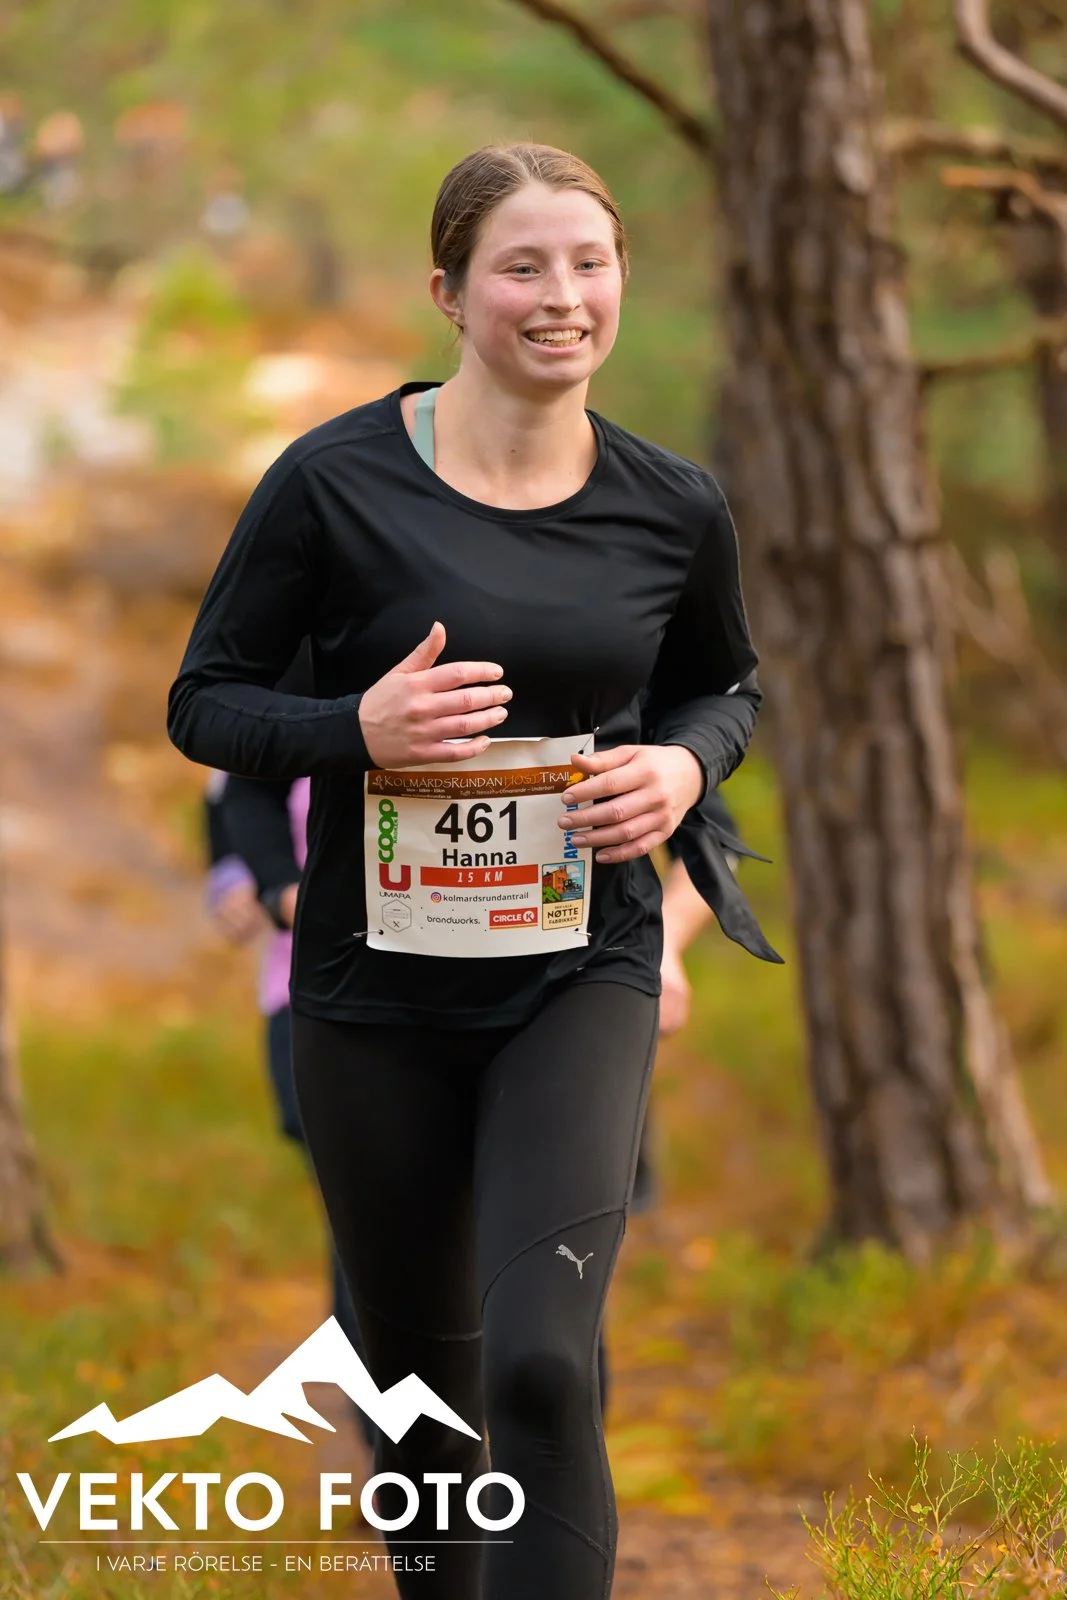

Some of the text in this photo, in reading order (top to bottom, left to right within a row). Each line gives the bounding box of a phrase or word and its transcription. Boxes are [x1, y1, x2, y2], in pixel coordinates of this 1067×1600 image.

[435, 801, 517, 843] 461
[378, 799, 398, 864] coop
[442, 848, 518, 867] Hanna
[458, 871, 504, 883] 15 KM
[379, 892, 412, 900] UMARA
[443, 892, 529, 903] kolmardsrundantrail
[547, 907, 579, 918] NØTTE
[493, 914, 522, 923] CIRCLE
